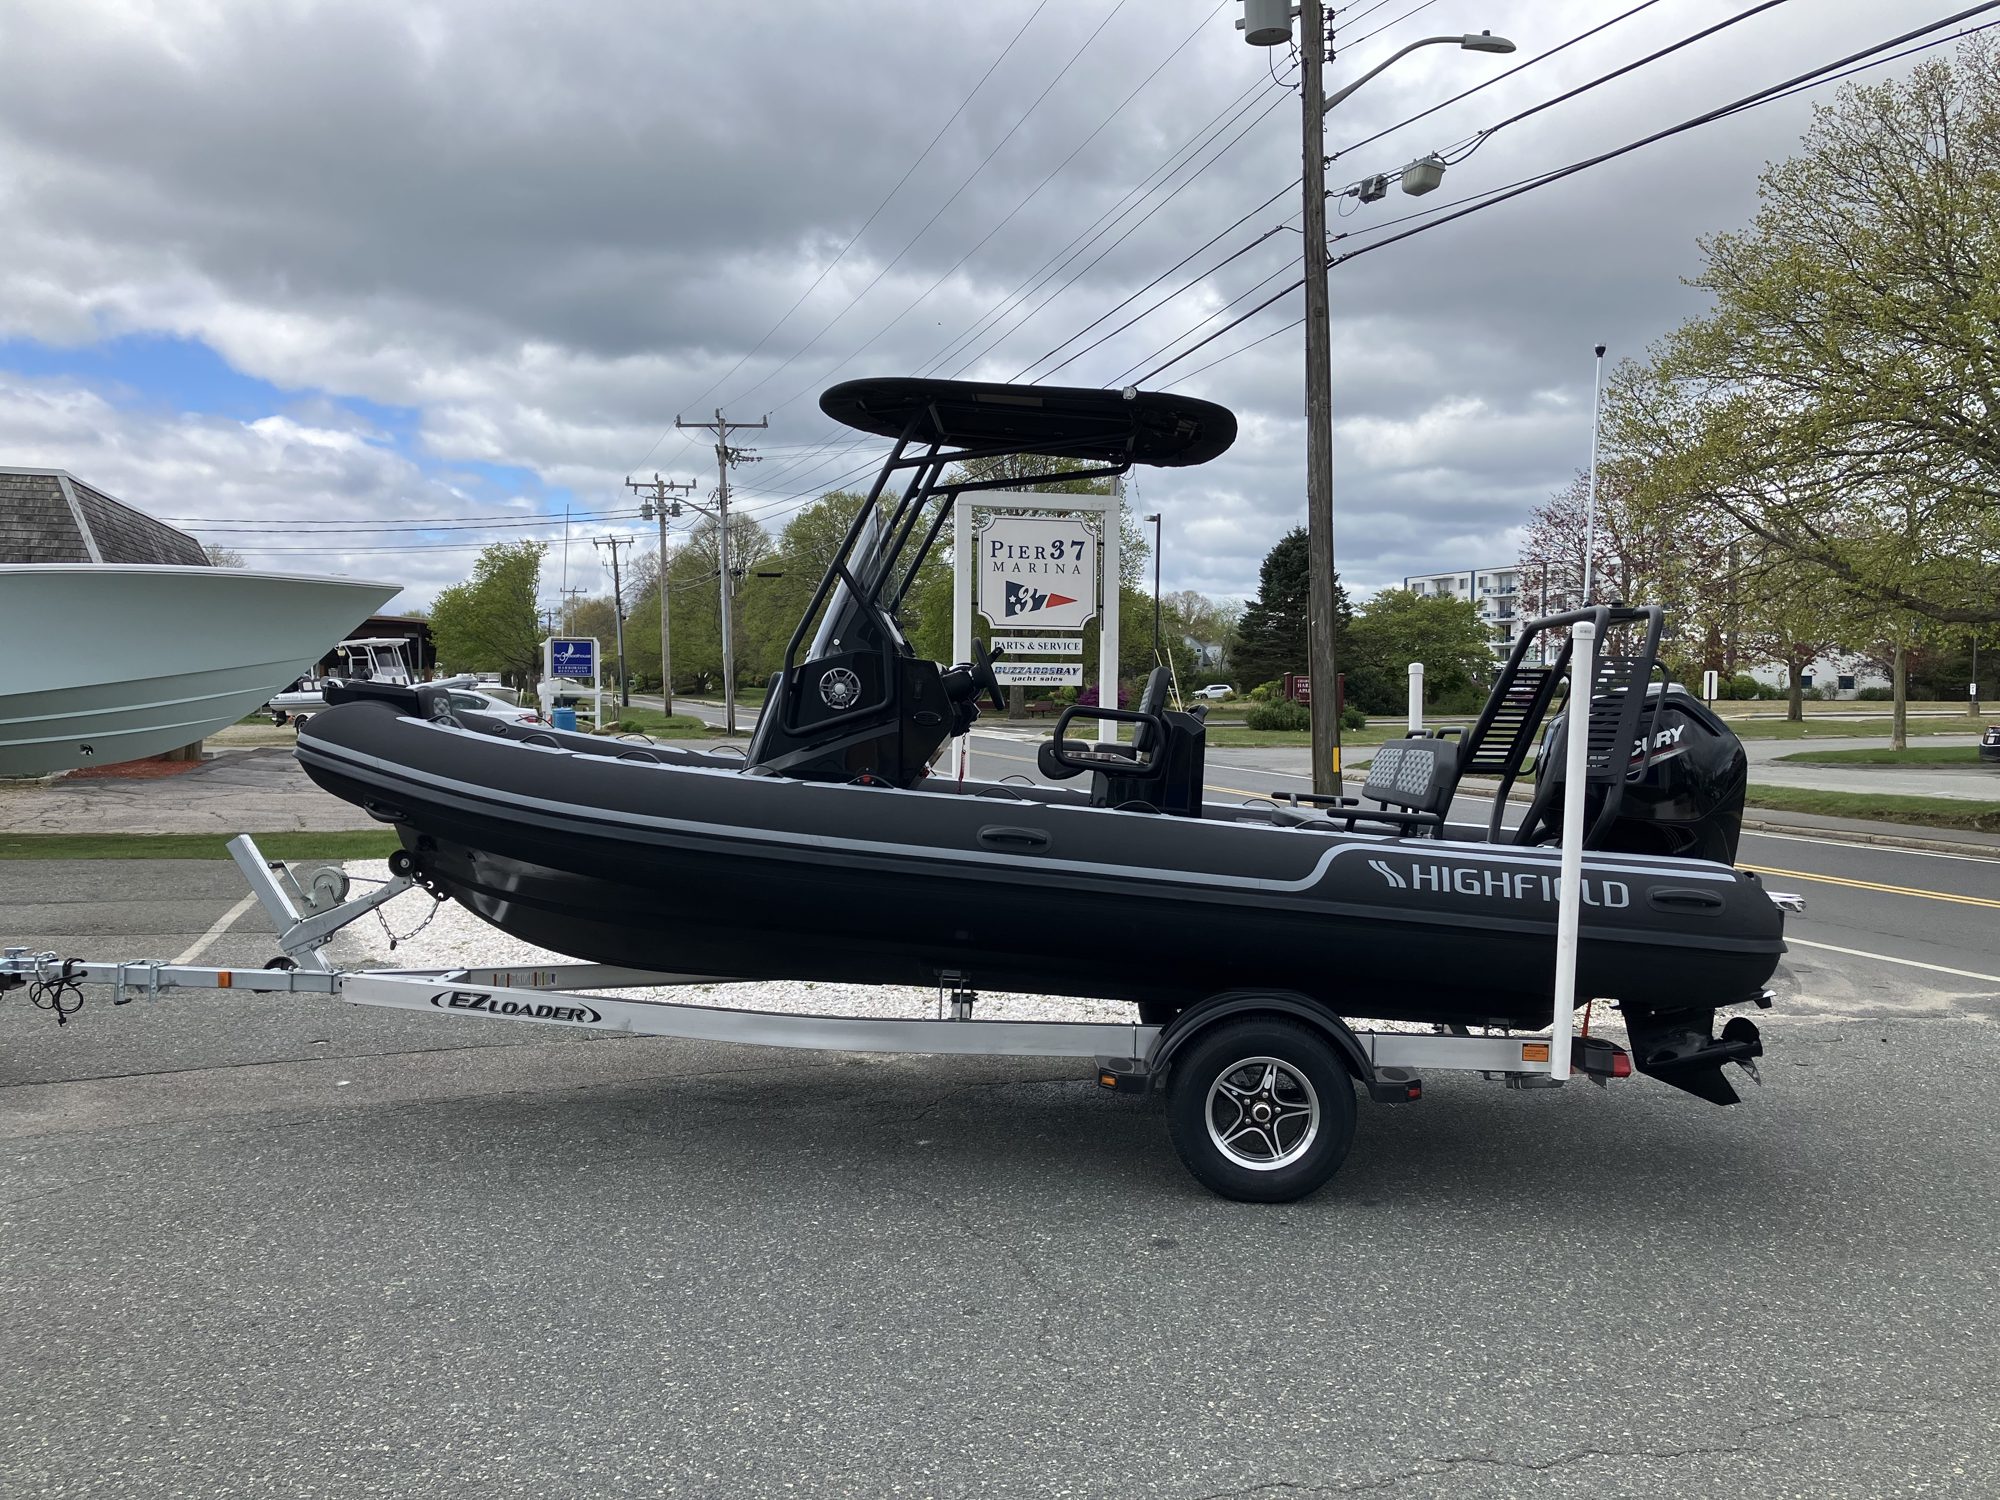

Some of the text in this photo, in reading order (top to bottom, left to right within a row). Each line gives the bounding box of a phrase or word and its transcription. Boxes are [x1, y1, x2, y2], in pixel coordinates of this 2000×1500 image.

[992, 561, 1081, 575] MARINA
[994, 641, 1081, 651] PARTS & SERVICE
[1011, 675, 1037, 683] yacht
